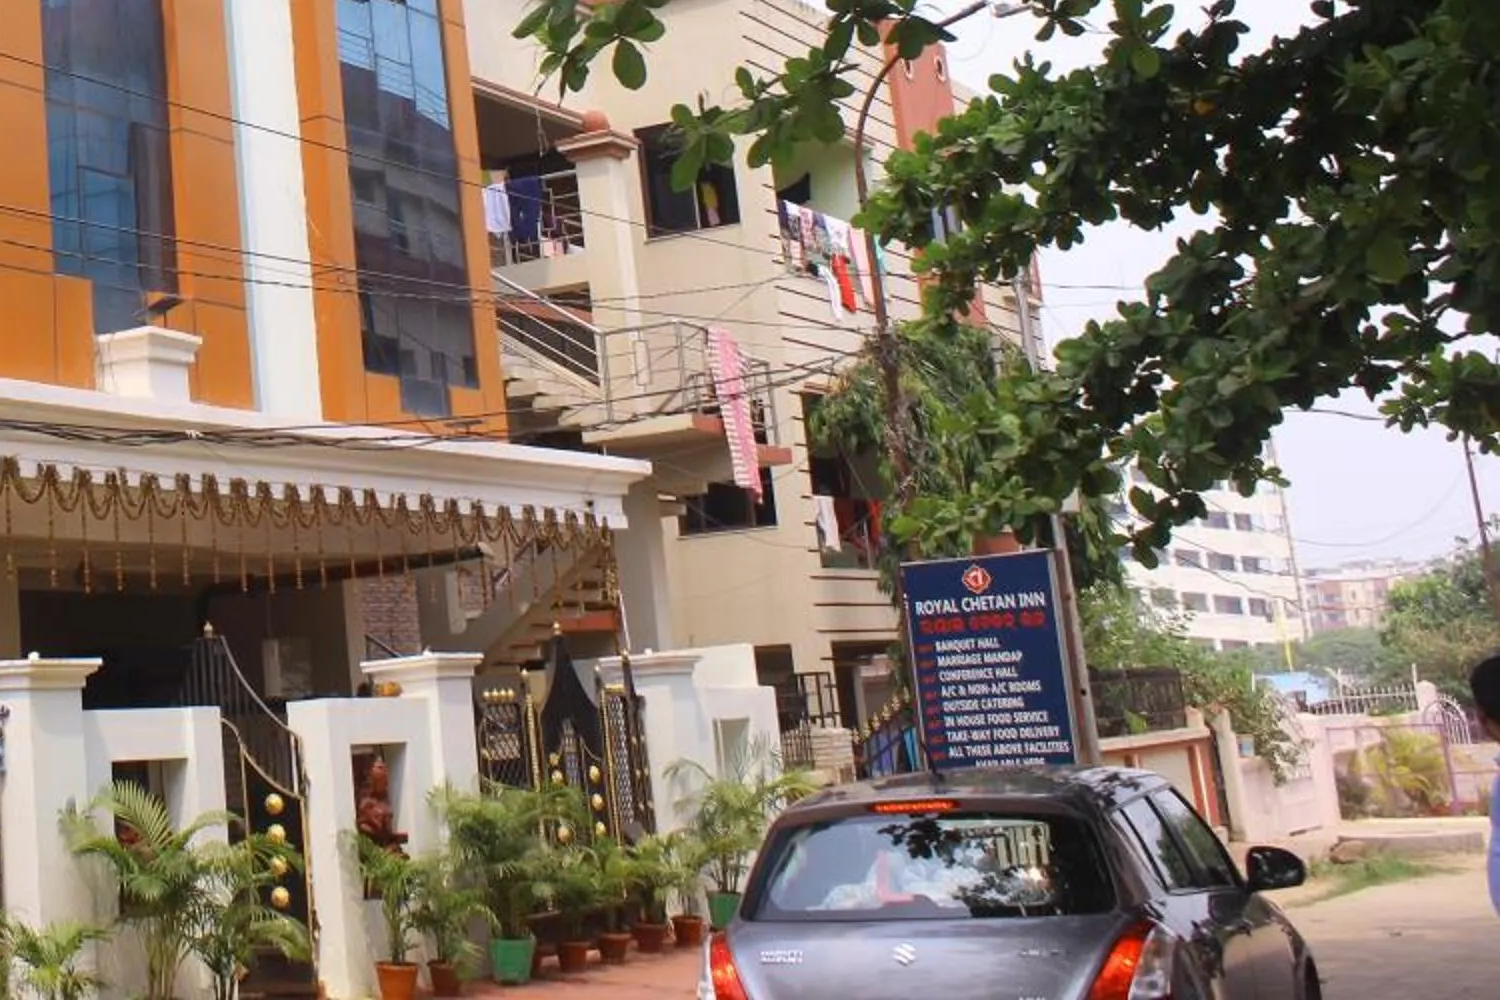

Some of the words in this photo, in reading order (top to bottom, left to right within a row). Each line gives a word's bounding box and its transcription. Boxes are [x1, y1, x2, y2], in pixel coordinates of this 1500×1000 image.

[916, 599, 960, 616] ROYAL
[962, 595, 1017, 612] CHETAN
[1020, 592, 1047, 608] INN
[978, 637, 1000, 648] HALL
[938, 655, 983, 668] MARRIAGE
[985, 652, 1022, 664] MANDAP
[939, 669, 994, 682] CONFERENCE
[996, 666, 1018, 677] HALL
[942, 686, 957, 698] A/C
[1009, 680, 1042, 693] ROOMS
[943, 701, 980, 713] OUTSIDE
[982, 697, 1025, 710] CATERING
[944, 716, 956, 727] IN
[958, 714, 986, 726] HOUSE
[988, 713, 1013, 725] FOOD
[1014, 711, 1049, 723] SERVICE
[993, 728, 1018, 740] FOOD
[1020, 726, 1060, 738] DELIVERY
[949, 747, 964, 758] ALL
[966, 745, 992, 757] THESE
[994, 743, 1023, 755] ABOVE
[1025, 741, 1070, 754] FACILITIES
